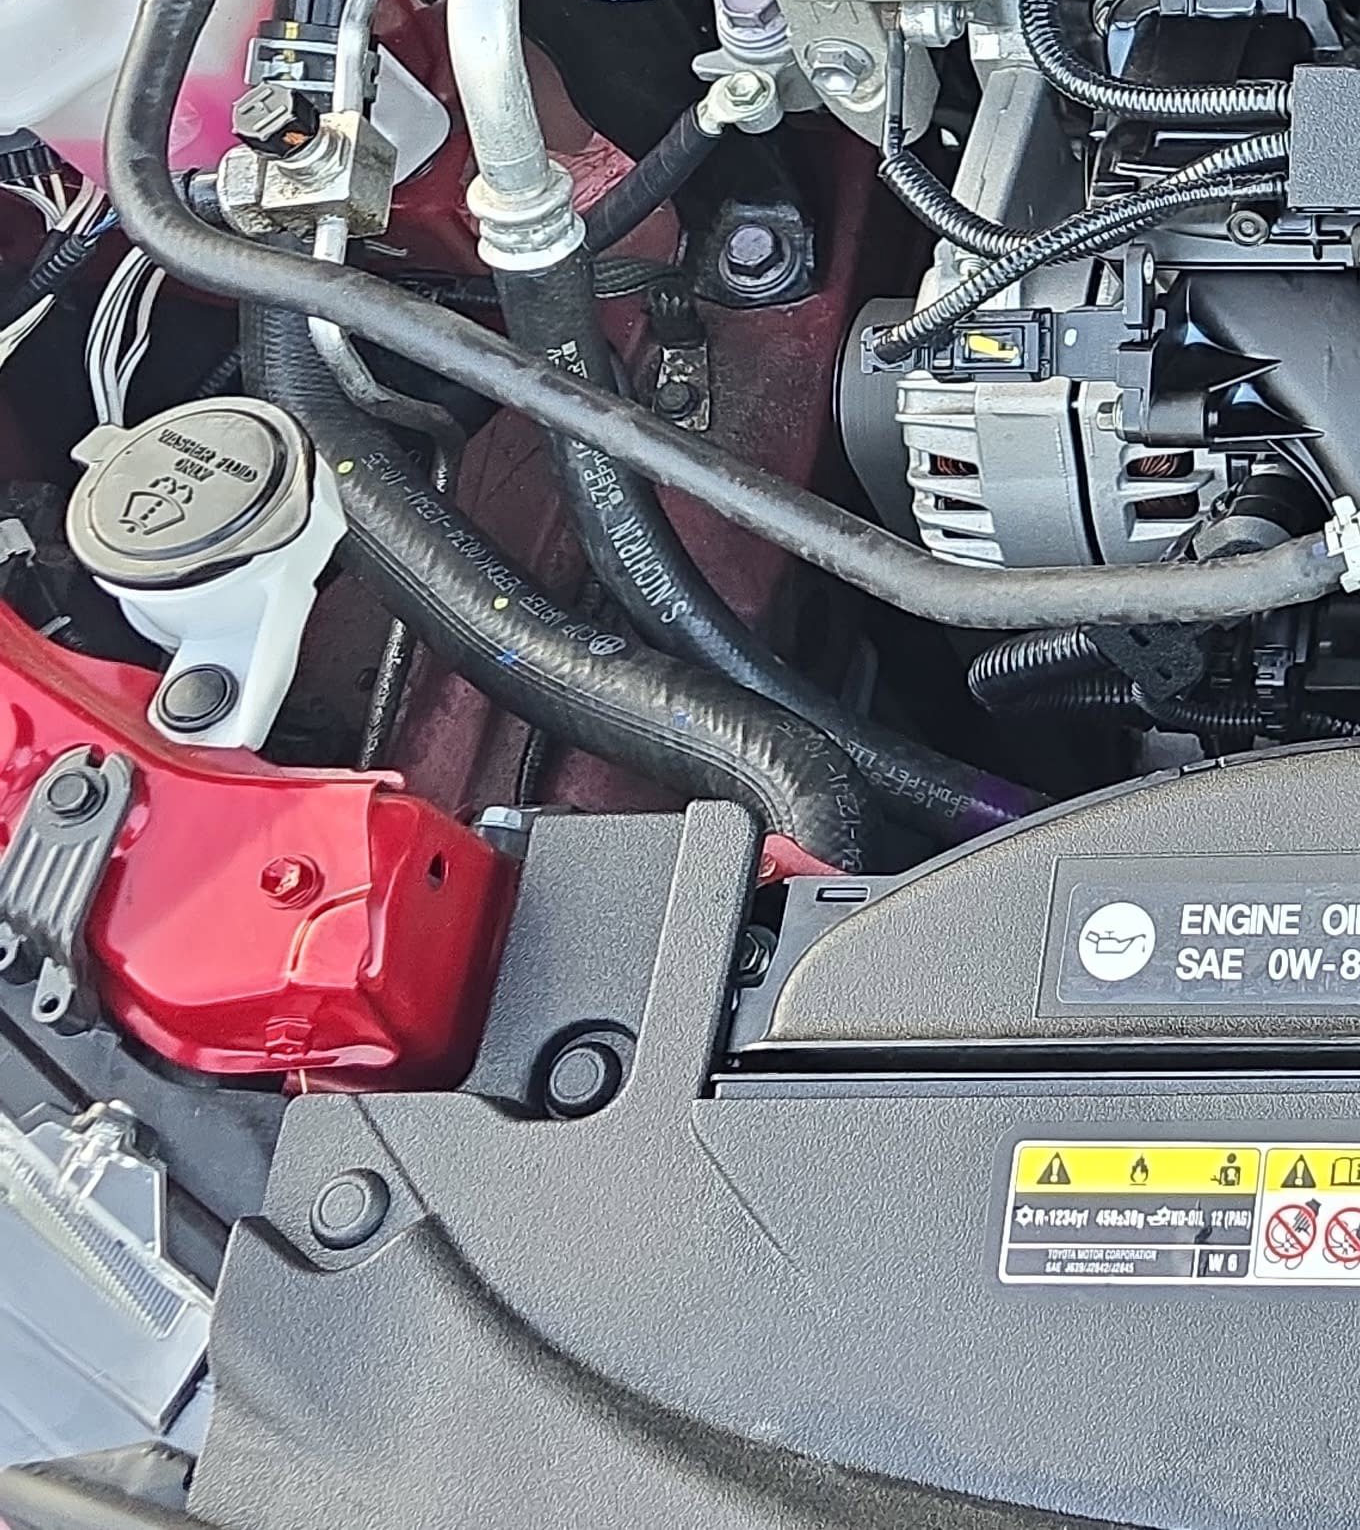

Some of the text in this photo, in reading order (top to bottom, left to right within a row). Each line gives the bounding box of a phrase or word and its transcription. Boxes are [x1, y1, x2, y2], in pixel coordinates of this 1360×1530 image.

[158, 428, 217, 464] WASHER
[174, 458, 215, 483] ONLY
[1179, 903, 1302, 936] ENGINE
[1175, 947, 1245, 981] SAE
[1045, 1261, 1061, 1273] SAE
[1047, 1248, 1157, 1261] TOYOTA MOTOR CORPORATION
